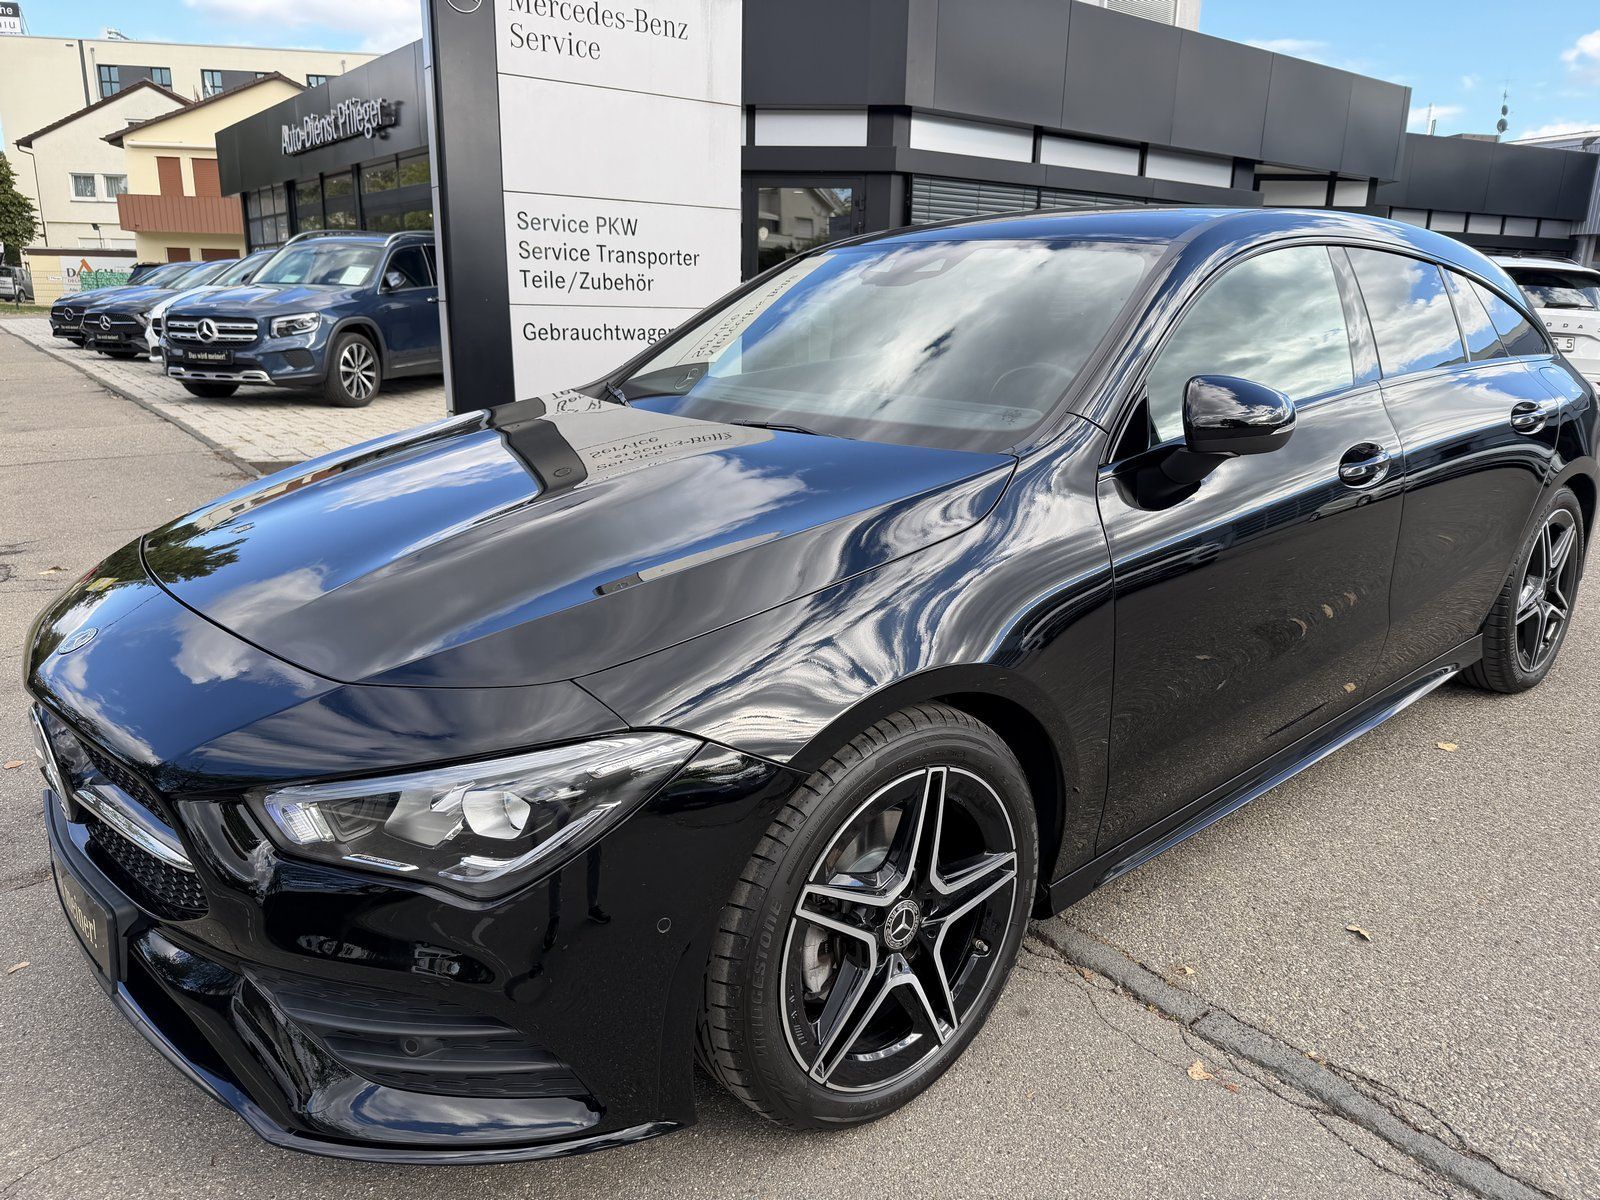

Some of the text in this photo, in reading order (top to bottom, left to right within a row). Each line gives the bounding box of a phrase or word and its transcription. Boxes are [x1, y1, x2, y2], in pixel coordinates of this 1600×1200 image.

[508, 0, 689, 41] Mercedes-Benz
[510, 22, 601, 60] Service
[281, 113, 337, 155] Auto-Dienst
[517, 211, 638, 236] Service PKW
[518, 241, 699, 268] Service Transporter
[520, 268, 654, 294] Teile/Zubehör
[188, 351, 197, 359] Das
[1566, 339, 1573, 349] 5
